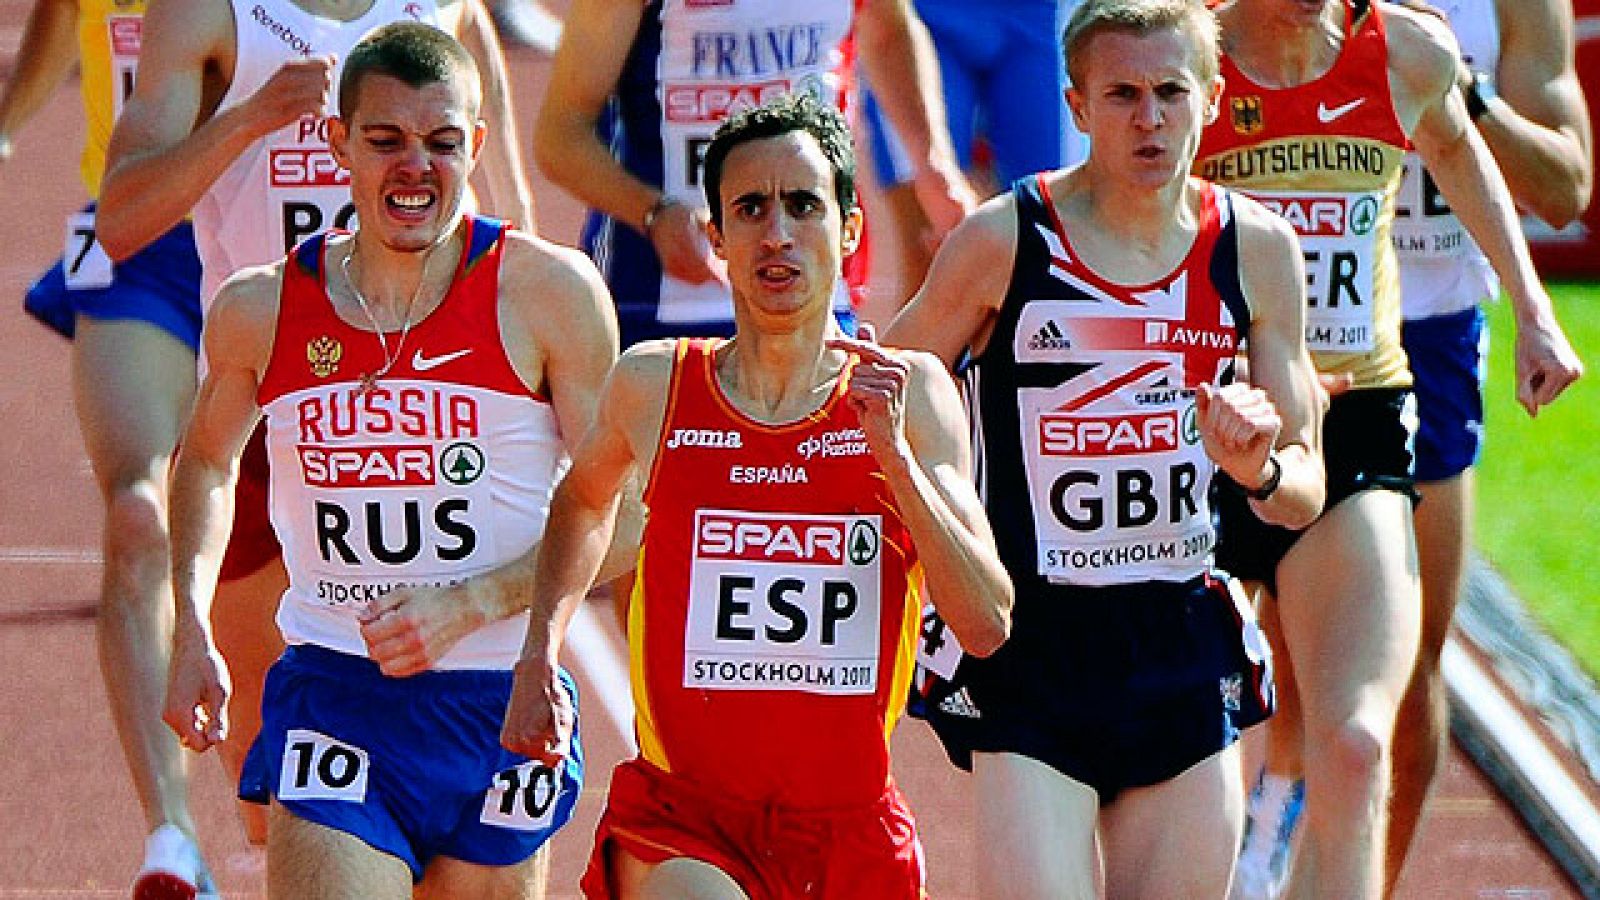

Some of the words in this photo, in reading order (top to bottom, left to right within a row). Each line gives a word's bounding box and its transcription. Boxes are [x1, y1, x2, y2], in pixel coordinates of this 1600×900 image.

[251, 4, 312, 56] Reebok
[693, 24, 823, 76] FRANCE
[1203, 141, 1384, 181] DEUTSCHLAND
[69, 226, 96, 277] 7
[1171, 326, 1237, 349] AVIVA
[1338, 324, 1367, 346] 2011
[296, 388, 479, 443] RUSSIA
[1044, 416, 1176, 453] SPAR
[303, 450, 433, 484] SPAR
[729, 462, 808, 484] ESPAÑA
[1049, 461, 1199, 533] GBR
[315, 499, 477, 566] RUS
[700, 521, 842, 560] SPAR
[1046, 541, 1176, 569] STOCKHOLM
[715, 574, 859, 646] ESP
[693, 659, 835, 686] STOCKHOLM
[841, 665, 872, 687] 2011
[290, 741, 362, 789] 10
[498, 765, 556, 819] 10
